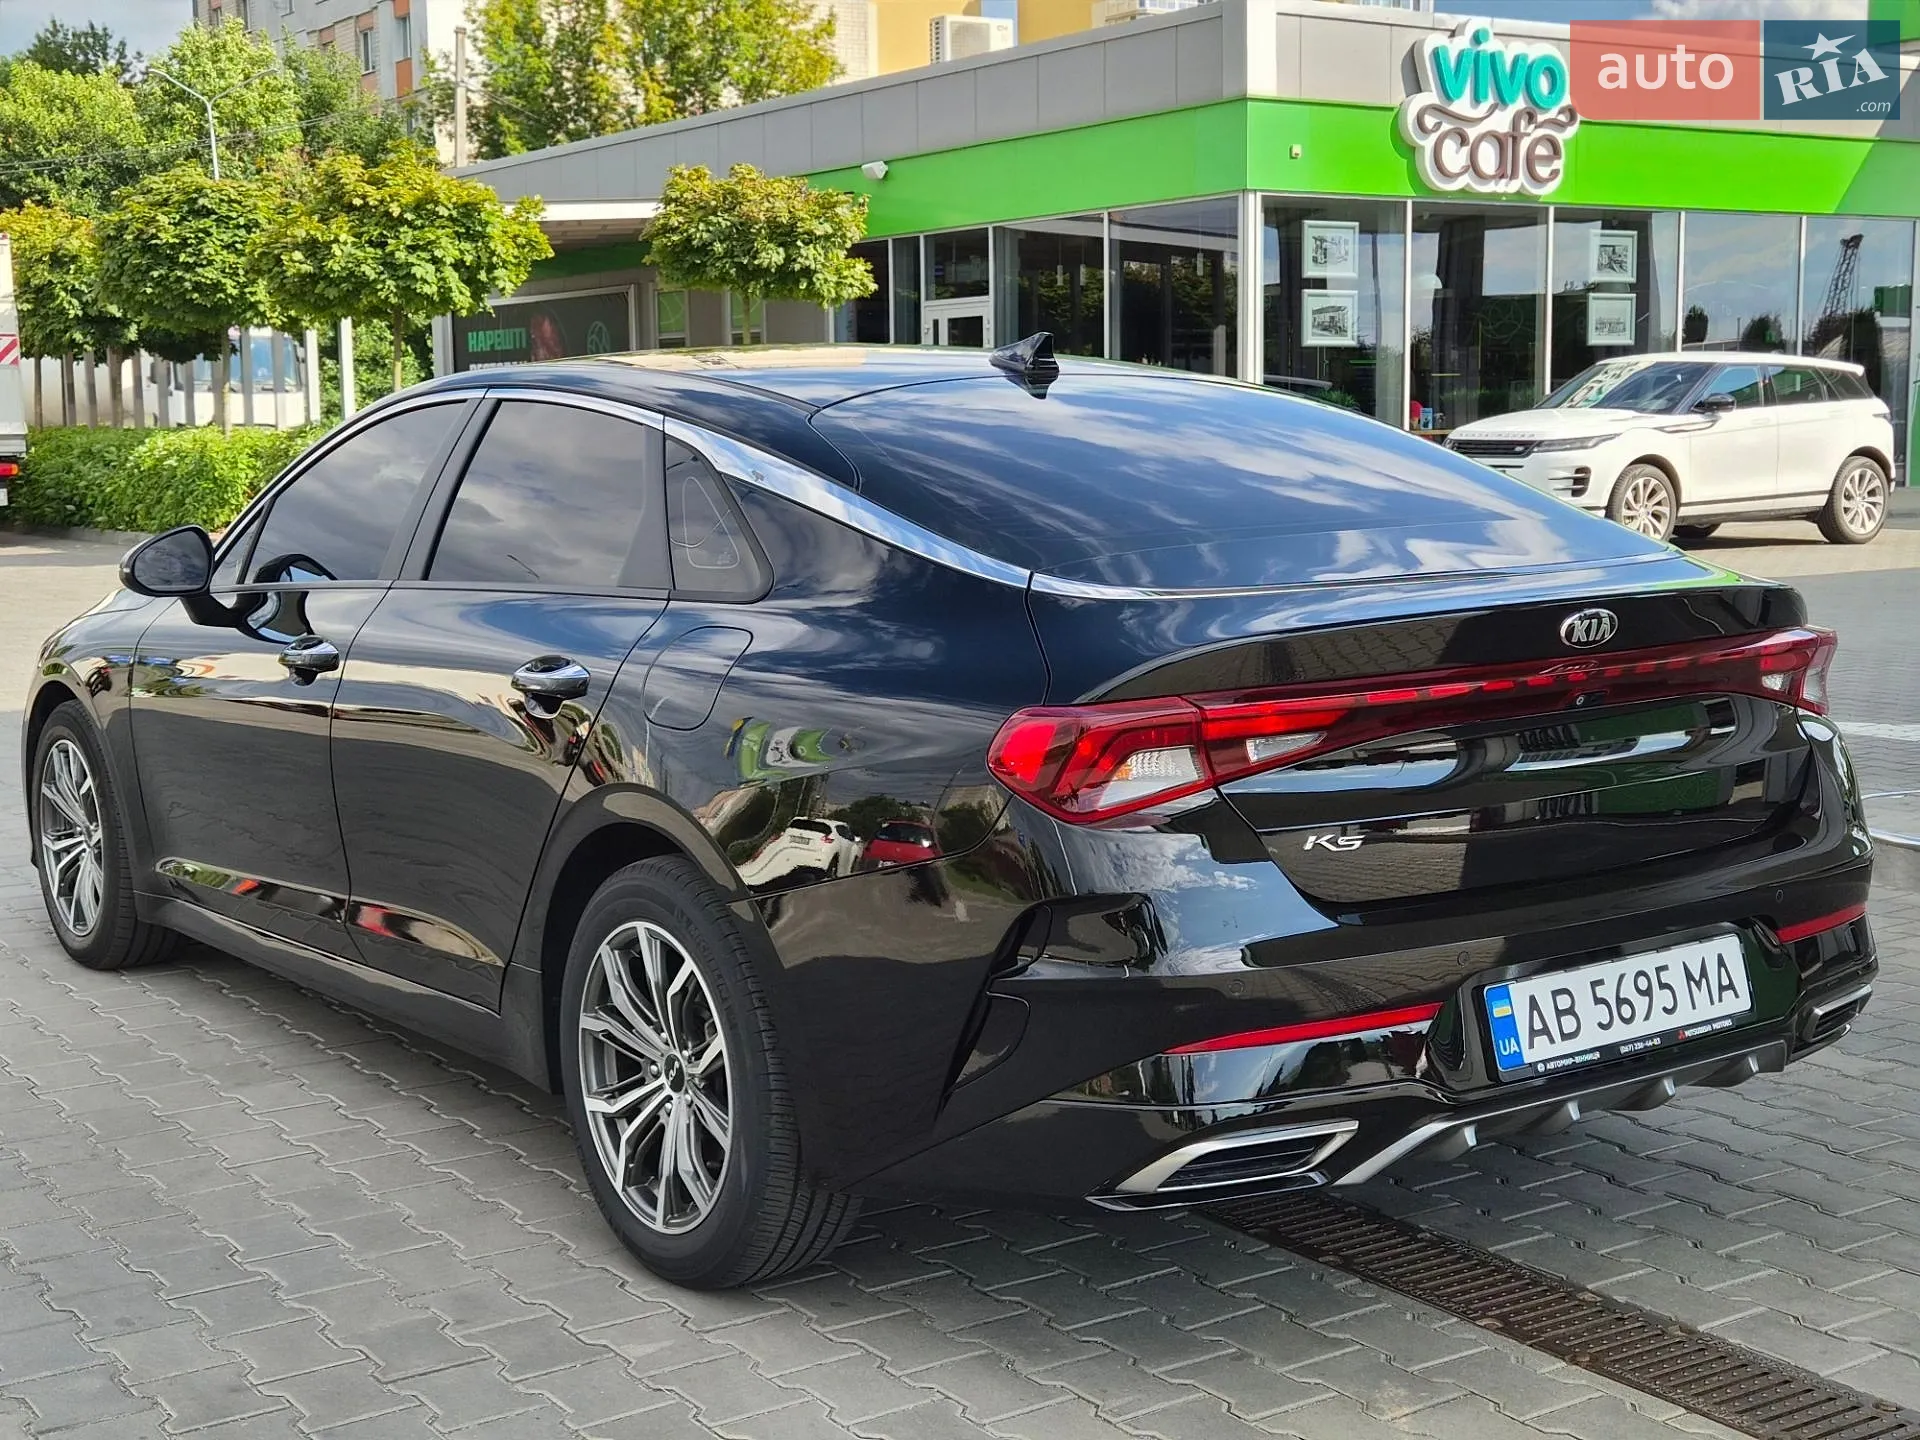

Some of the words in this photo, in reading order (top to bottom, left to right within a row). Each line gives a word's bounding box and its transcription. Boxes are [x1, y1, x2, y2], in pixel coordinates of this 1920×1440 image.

[1432, 27, 1566, 109] vivo
[1571, 616, 1610, 642] KIA
[1303, 833, 1365, 852] K5
[1527, 987, 1582, 1049] AB
[1590, 964, 1679, 1031] 5695
[1682, 952, 1740, 1011] MA
[1499, 1037, 1520, 1056] UA
